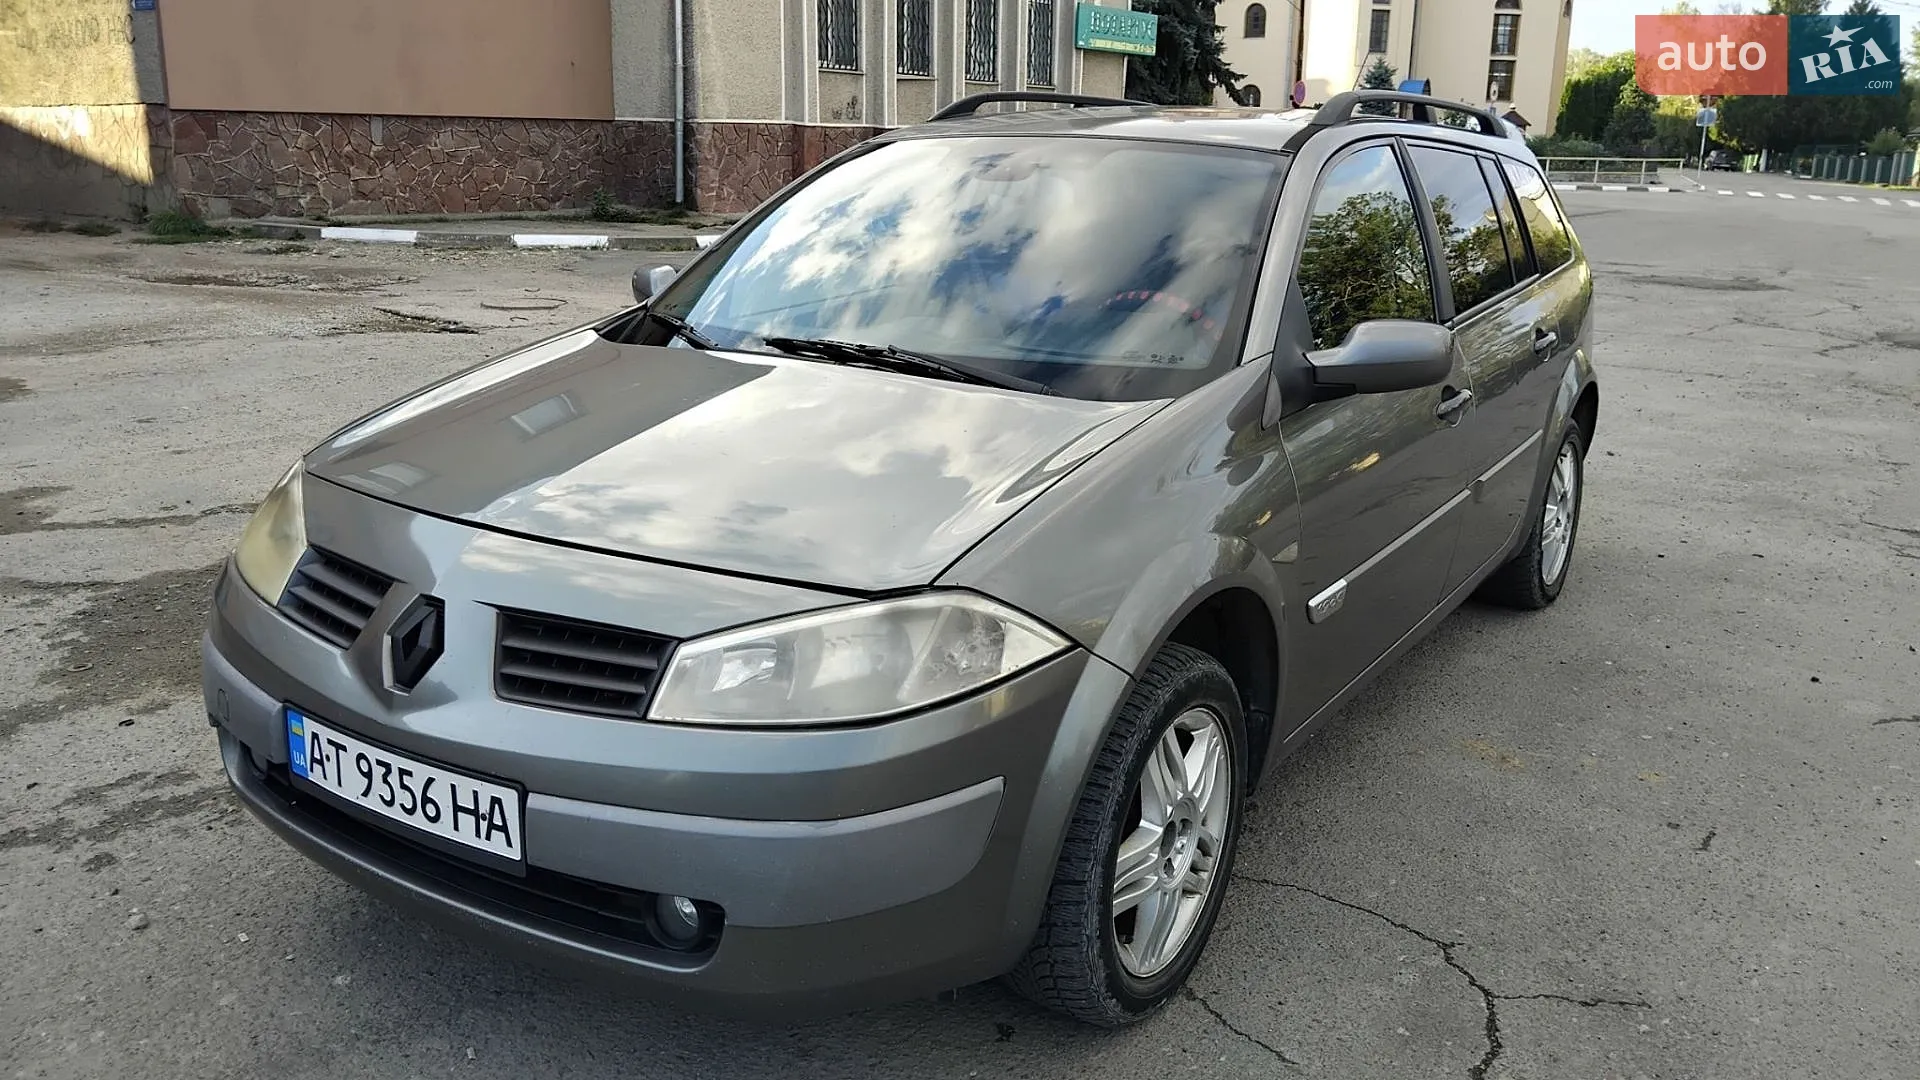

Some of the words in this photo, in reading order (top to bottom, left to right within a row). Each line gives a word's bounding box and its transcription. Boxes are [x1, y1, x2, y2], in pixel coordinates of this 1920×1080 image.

[293, 750, 306, 769] UA
[309, 731, 348, 787] AT
[355, 752, 441, 823] 9356
[450, 783, 513, 848] HA
